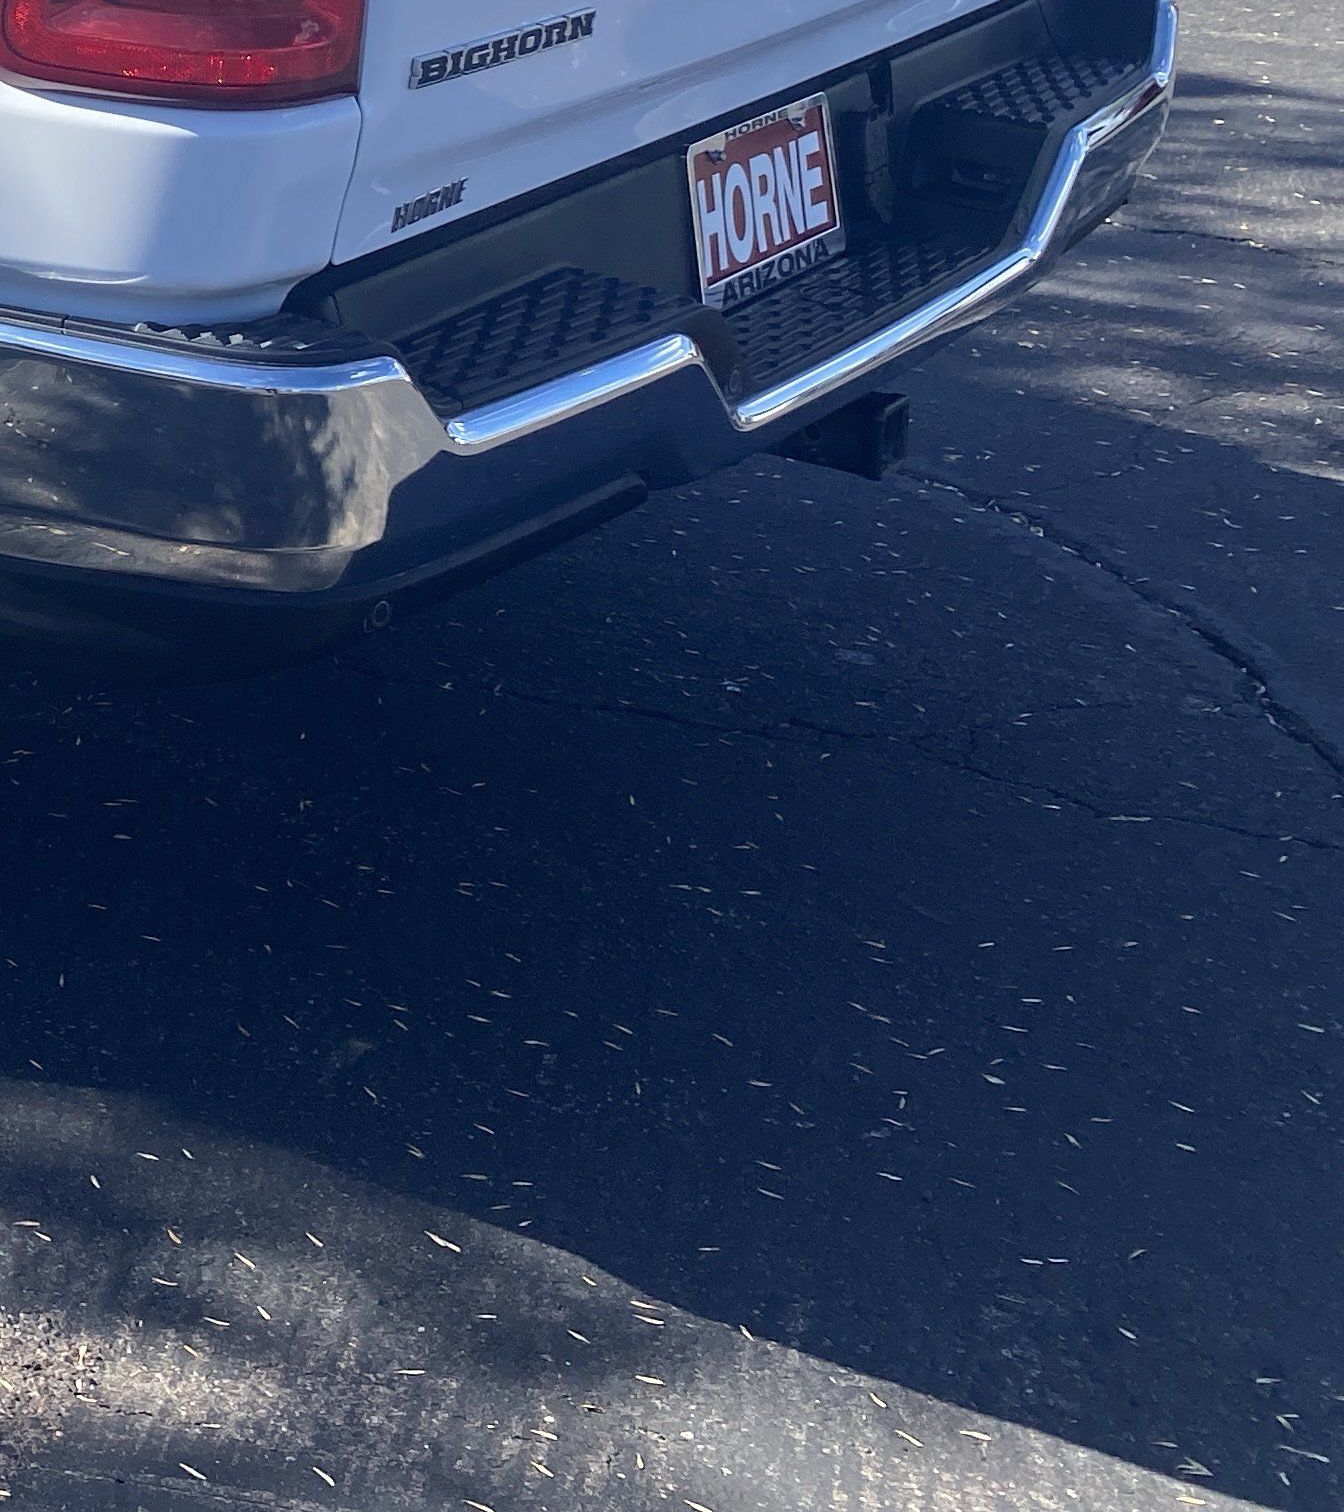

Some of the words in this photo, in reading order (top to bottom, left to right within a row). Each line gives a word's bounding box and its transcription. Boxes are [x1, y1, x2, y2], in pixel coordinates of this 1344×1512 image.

[408, 7, 597, 89] BIGHORN
[724, 107, 791, 142] HORNE
[390, 176, 469, 233] HORNE
[697, 130, 830, 278] HORNE
[722, 237, 831, 307] ARIZONA
